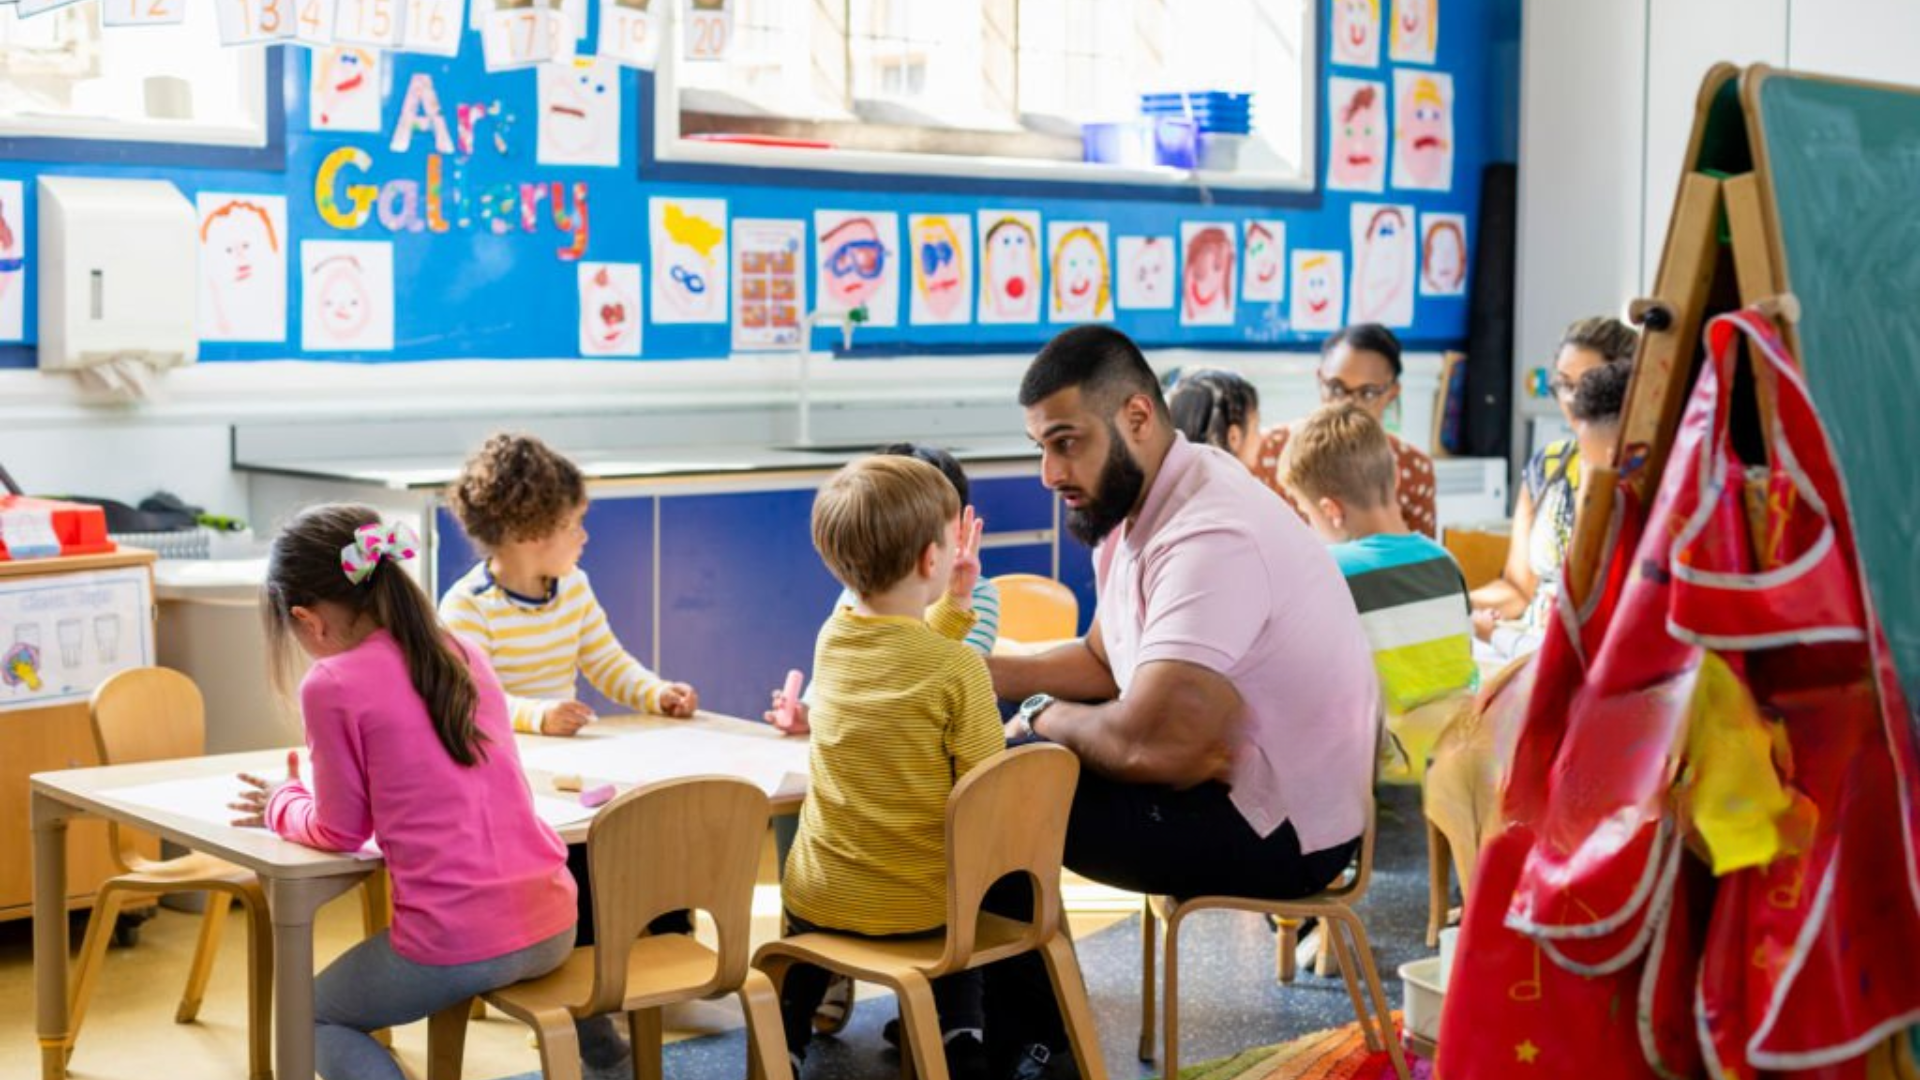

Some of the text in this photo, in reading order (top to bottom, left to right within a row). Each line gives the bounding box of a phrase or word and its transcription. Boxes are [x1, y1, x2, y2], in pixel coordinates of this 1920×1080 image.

[239, 0, 281, 35] 13
[354, 0, 391, 37] 15
[411, 0, 445, 41] 16
[504, 14, 538, 58] 17
[618, 17, 647, 52] 19
[694, 17, 726, 57] 20
[316, 147, 588, 260] Gallery
